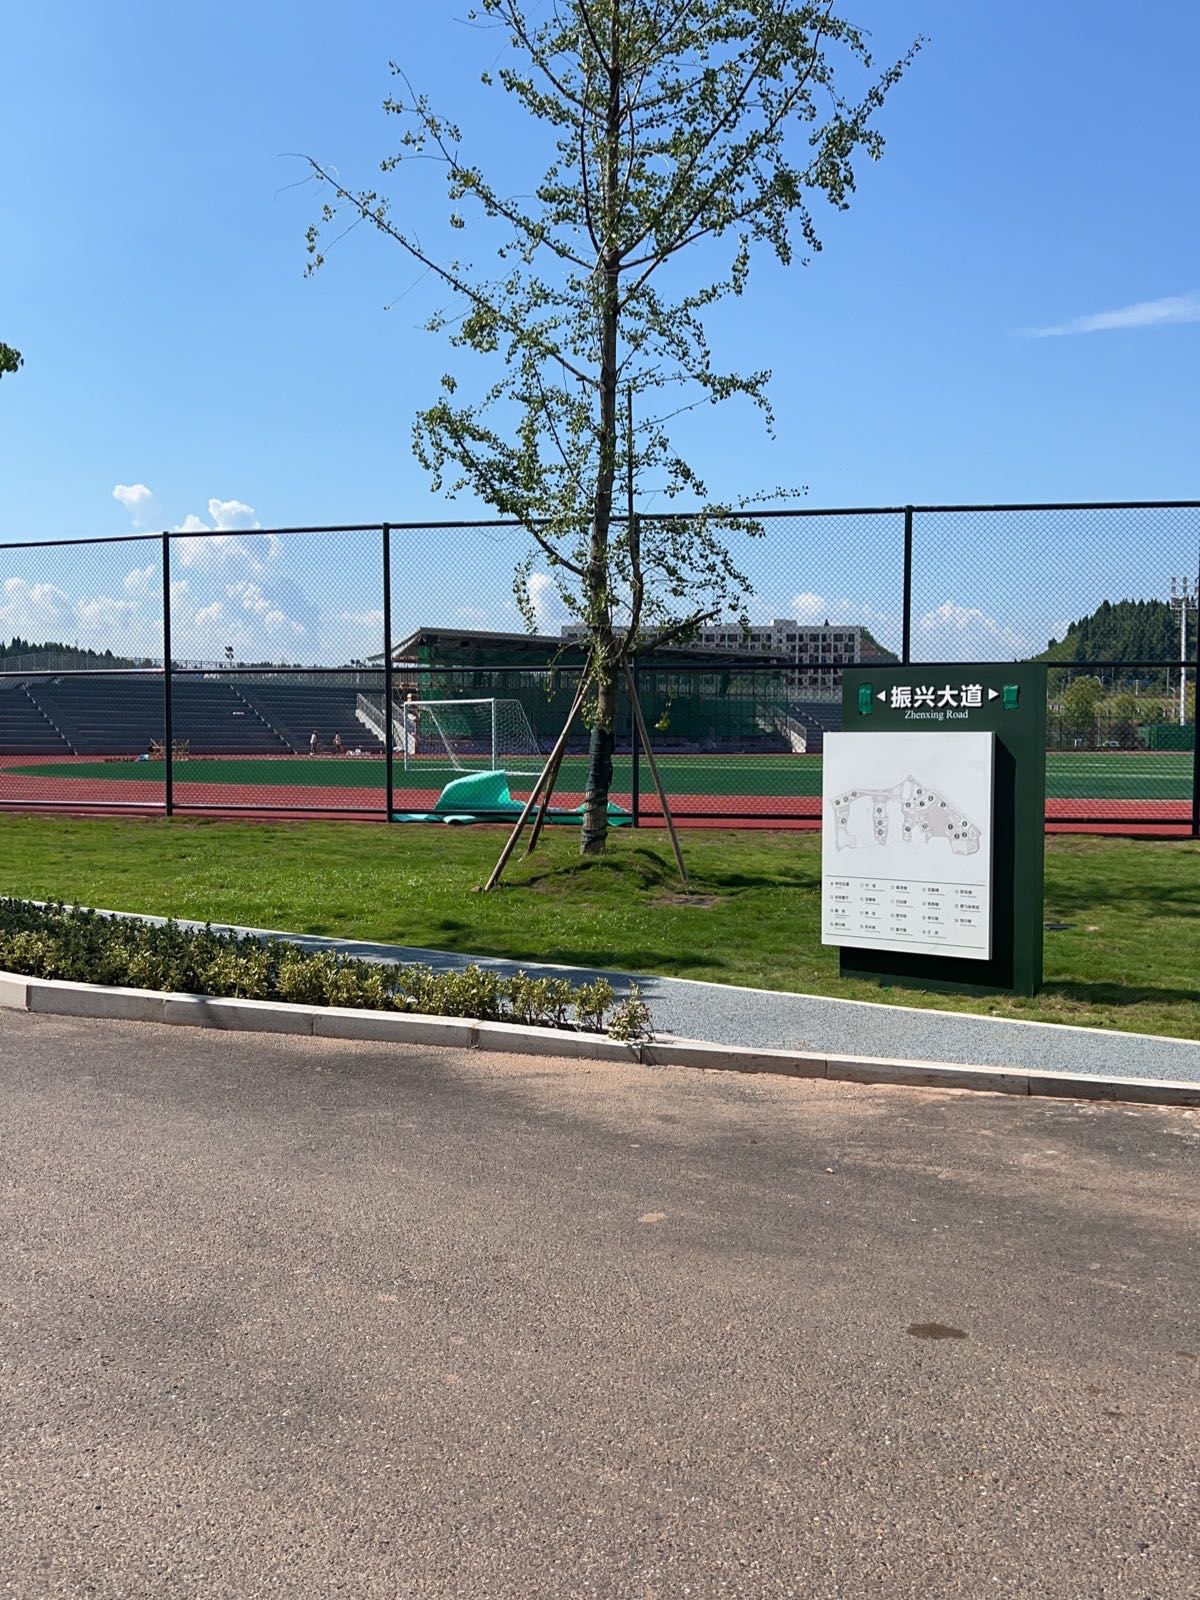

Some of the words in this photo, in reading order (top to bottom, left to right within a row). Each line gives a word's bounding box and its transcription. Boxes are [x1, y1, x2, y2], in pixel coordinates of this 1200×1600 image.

[890, 684, 983, 708] 振兴大道
[904, 710, 944, 720] Zhenxing
[946, 710, 969, 719] Road
